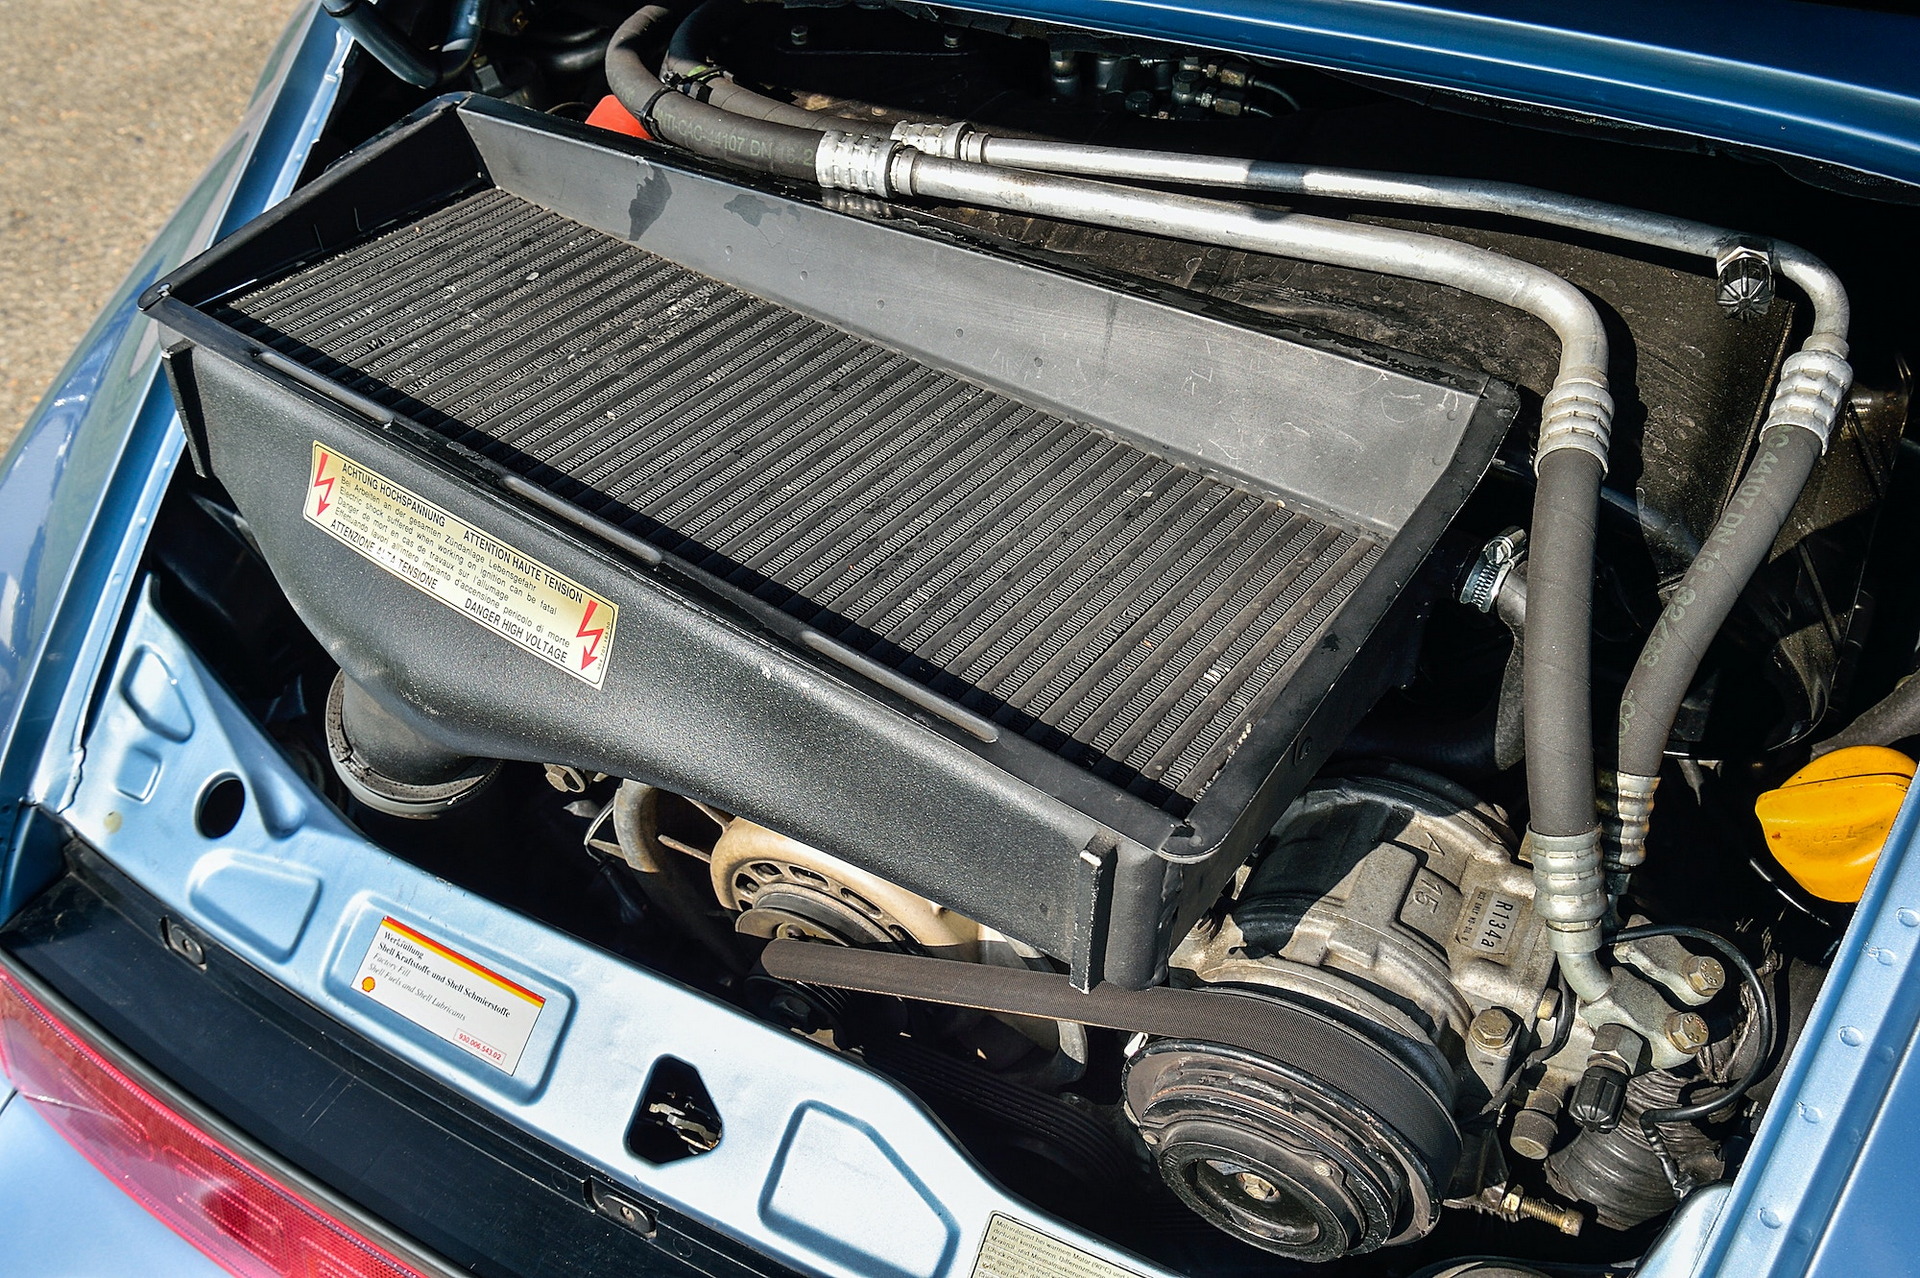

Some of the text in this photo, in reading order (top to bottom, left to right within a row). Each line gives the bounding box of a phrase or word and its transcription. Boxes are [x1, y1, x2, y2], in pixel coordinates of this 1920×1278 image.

[342, 463, 446, 527] ACHTUNG HOCHSPANNUNG
[1736, 451, 1778, 509] 44107
[330, 519, 376, 552] ATTENZIONE
[399, 559, 438, 590] TENSIONE
[338, 497, 359, 515] Danger
[362, 512, 370, 522] de
[373, 520, 388, 532] mort
[391, 529, 399, 538] en
[402, 537, 414, 547] cas
[417, 544, 426, 554] de
[429, 552, 455, 571] travaux
[458, 569, 470, 578] sur
[340, 486, 557, 615] Electric shock suffered when working on ignition can be fatal
[341, 475, 536, 591] Bei Arbeiten an der gesamten Zündanlage Lebensgefahr
[1712, 512, 1746, 545] DN
[463, 530, 583, 604] ATTENTION HAUTE TENSION
[422, 559, 451, 581] impianto
[455, 579, 500, 608] d'accensione
[503, 607, 532, 627] pericolo
[536, 624, 544, 633] di
[548, 631, 570, 648] morte
[464, 598, 568, 663] DANGER HIGH VOLTAGE
[1481, 900, 1514, 948] R134a
[369, 963, 466, 1021] Shell Fuels and Shell Lubricants
[373, 953, 411, 977] Factory Fill
[378, 942, 511, 1018] Shell Kraftstoffe und Shell Schmierstoffe
